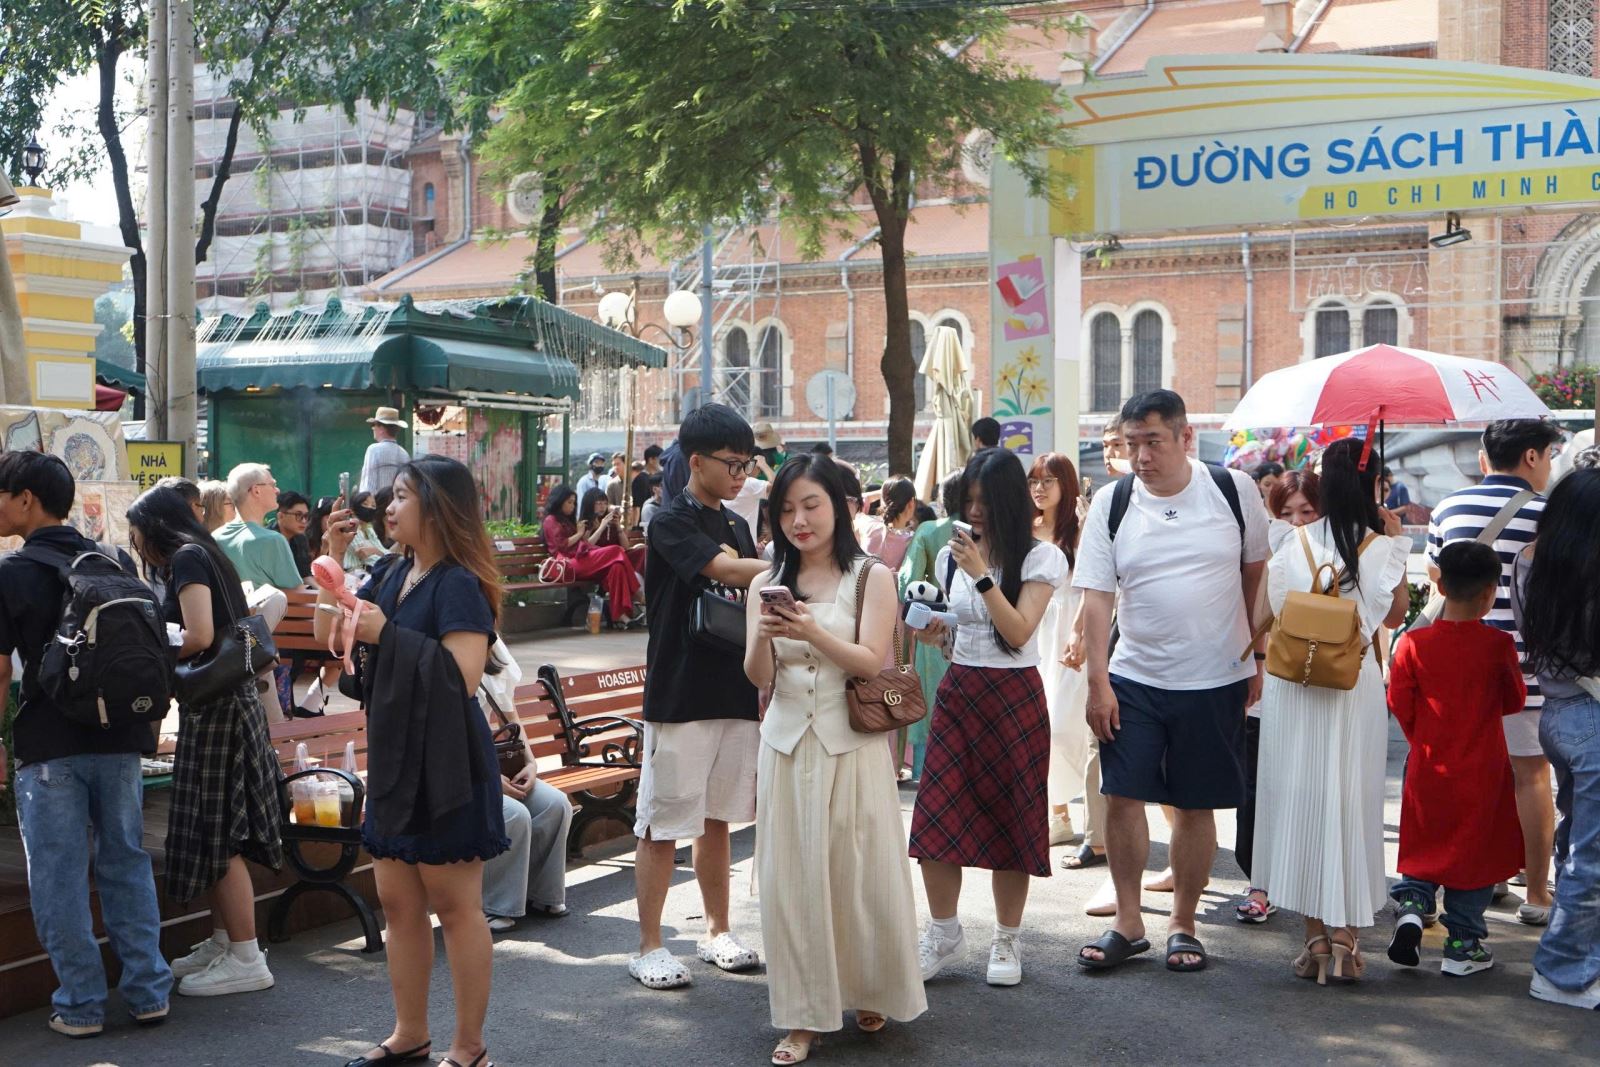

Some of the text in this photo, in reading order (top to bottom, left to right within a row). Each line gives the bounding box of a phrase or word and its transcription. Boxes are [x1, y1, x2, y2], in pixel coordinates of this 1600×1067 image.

[1133, 108, 1600, 190] ĐƯỜNG SÁCH THÀ
[1323, 190, 1358, 210] HO
[1387, 183, 1441, 206] CHI
[1472, 175, 1558, 199] MINH
[1462, 368, 1502, 403] A+
[141, 452, 167, 467] NHÀ
[131, 471, 146, 489] VỆ
[597, 670, 639, 688] HOASEN
